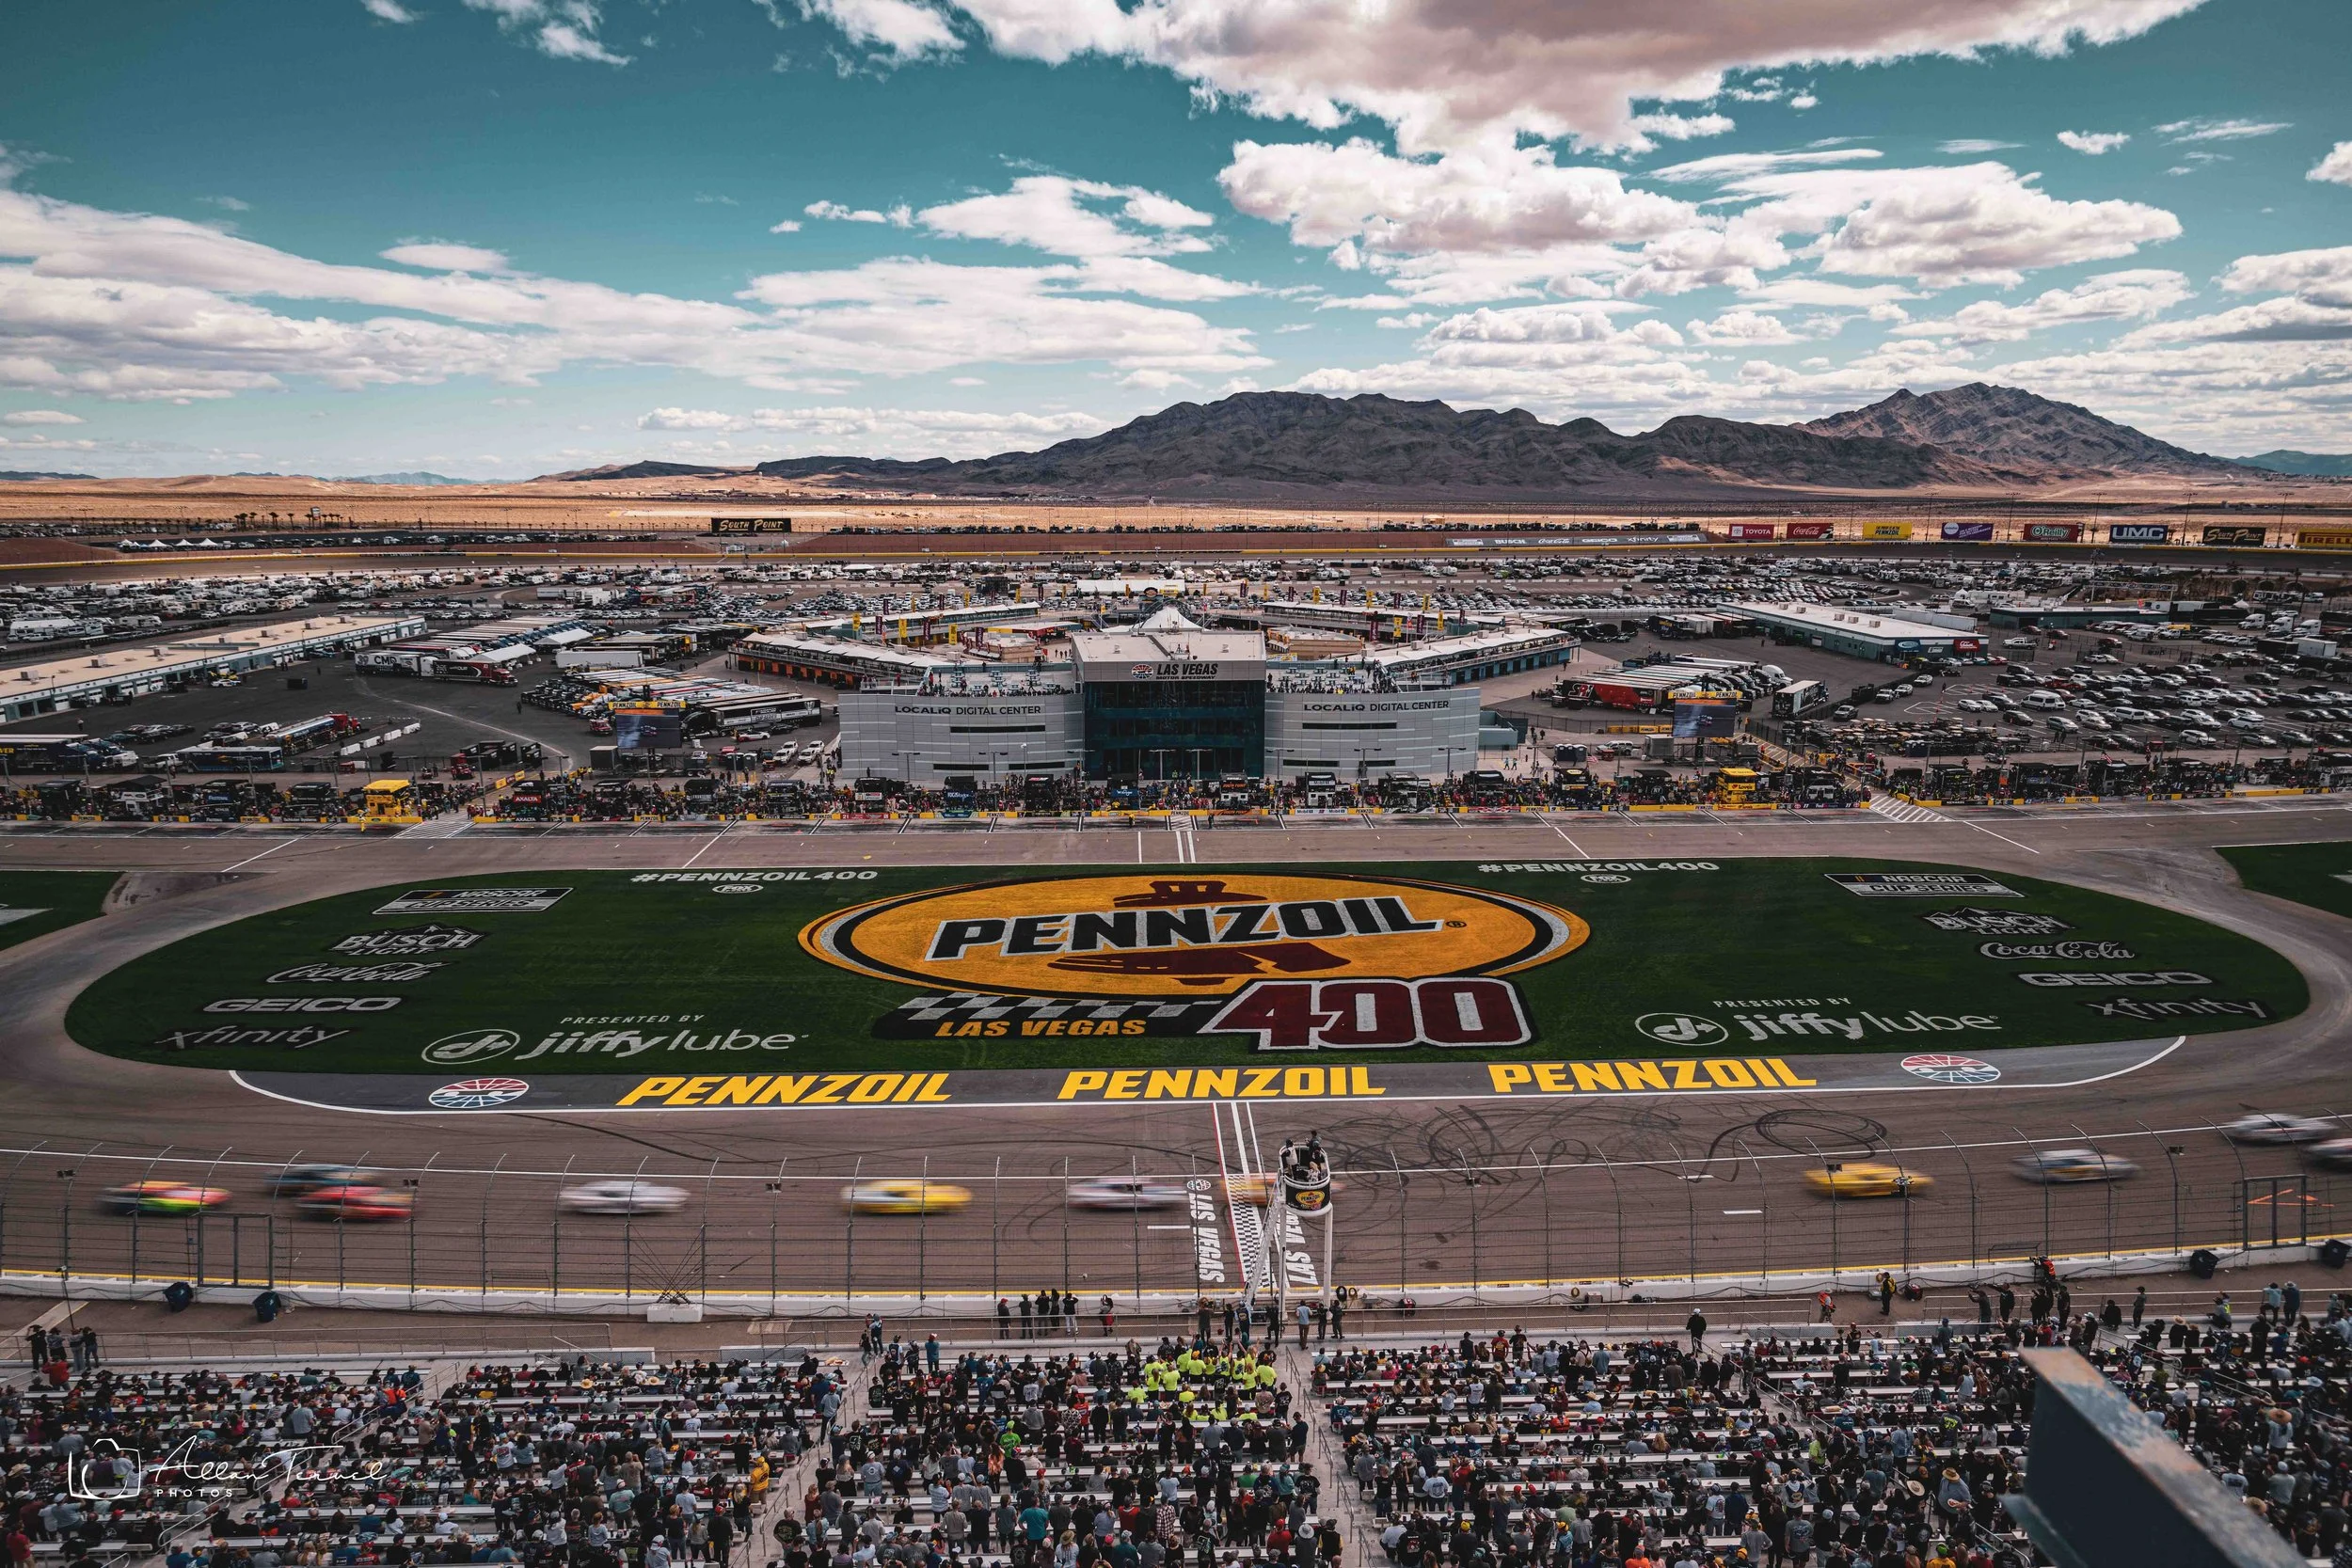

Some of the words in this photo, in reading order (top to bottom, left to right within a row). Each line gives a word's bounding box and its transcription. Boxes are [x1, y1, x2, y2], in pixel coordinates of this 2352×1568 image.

[719, 519, 750, 531] SOUTH
[754, 519, 785, 531] POINT
[2031, 525, 2068, 537] O'Reilly
[2112, 527, 2164, 540] UMC
[1157, 664, 1180, 675] LAS
[1182, 663, 1218, 675] VEGAS
[956, 706, 997, 716] DIGITAL
[999, 705, 1041, 715] CENTER
[1370, 702, 1409, 712] DIGITAL
[1411, 700, 1450, 710] CENTER
[1477, 862, 1721, 874] #PENNZOIL400
[630, 870, 878, 883] #PENNZOIL400
[1883, 875, 1967, 883] NASCAR
[451, 889, 548, 898] NASCAR
[1868, 884, 1913, 893] CUP
[1913, 884, 1989, 893] SERIES
[925, 895, 1445, 961] PENNZOIL
[1929, 914, 2072, 931] BUSCH
[1976, 927, 2055, 936] LIGHT
[333, 933, 483, 951] BUSCH
[348, 947, 436, 956] LIGHT
[1979, 941, 2136, 960] Coca-Cola
[266, 961, 450, 984] Coca-Cola
[2018, 972, 2213, 986] GEICO
[203, 997, 402, 1012] GEICO
[1713, 999, 1820, 1009] PRESENTED
[2087, 998, 2268, 1021] xfinity
[560, 1015, 672, 1025] PRESENTED
[677, 1014, 706, 1022] BY
[1197, 976, 1533, 1052] 400
[933, 1021, 1019, 1038] LAS
[1022, 1019, 1147, 1037] VEGAS
[1733, 1011, 1866, 1040] jiffy
[1860, 1010, 2002, 1033] lube
[153, 1025, 350, 1050] xfinity
[514, 1029, 669, 1061] jiffy
[666, 1028, 797, 1052] lube
[1487, 1056, 1818, 1093] PENNZOIL
[614, 1072, 953, 1107] PENNZOIL
[1057, 1065, 1389, 1101] PENNZOIL
[1188, 1193, 1216, 1222] LAS
[1193, 1227, 1226, 1283] VEGAS
[1284, 1249, 1319, 1287] LAS
[1395, 1405, 1407, 1416] 3
